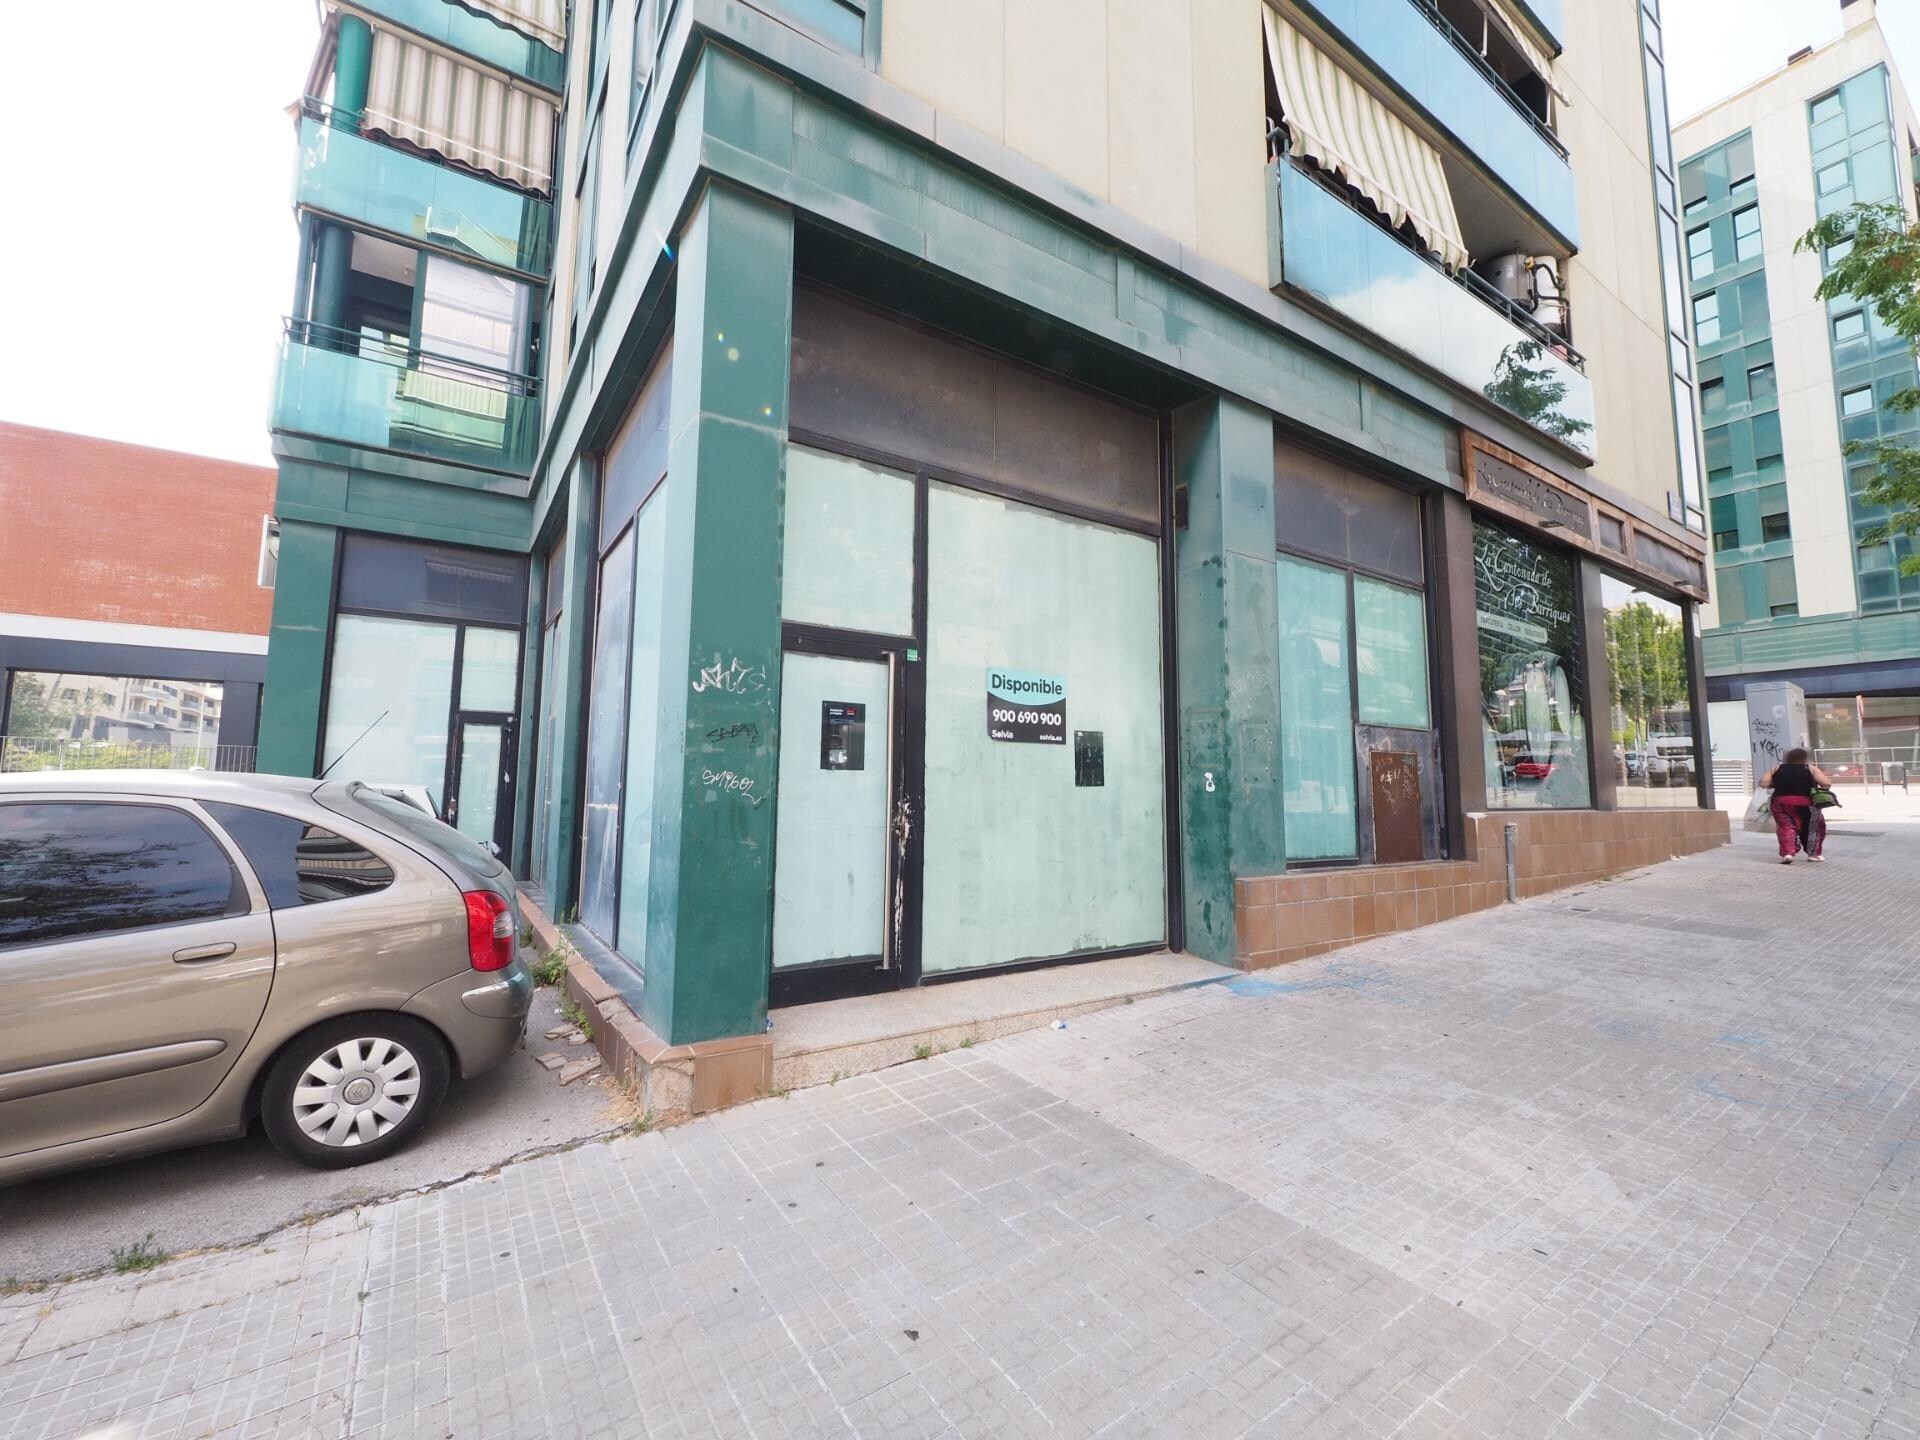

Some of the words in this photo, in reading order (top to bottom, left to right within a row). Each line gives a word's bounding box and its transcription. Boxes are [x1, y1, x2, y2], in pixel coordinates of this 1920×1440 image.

[1475, 544, 1504, 591] La
[1495, 546, 1542, 584] Cantonada
[1504, 584, 1570, 628] Barriques
[992, 674, 1063, 695] Disponible
[992, 709, 1016, 723] 900
[1017, 711, 1039, 724] 690
[1040, 712, 1062, 726] 900
[991, 729, 1014, 739] Solvia
[1040, 733, 1063, 742] solvia.es
